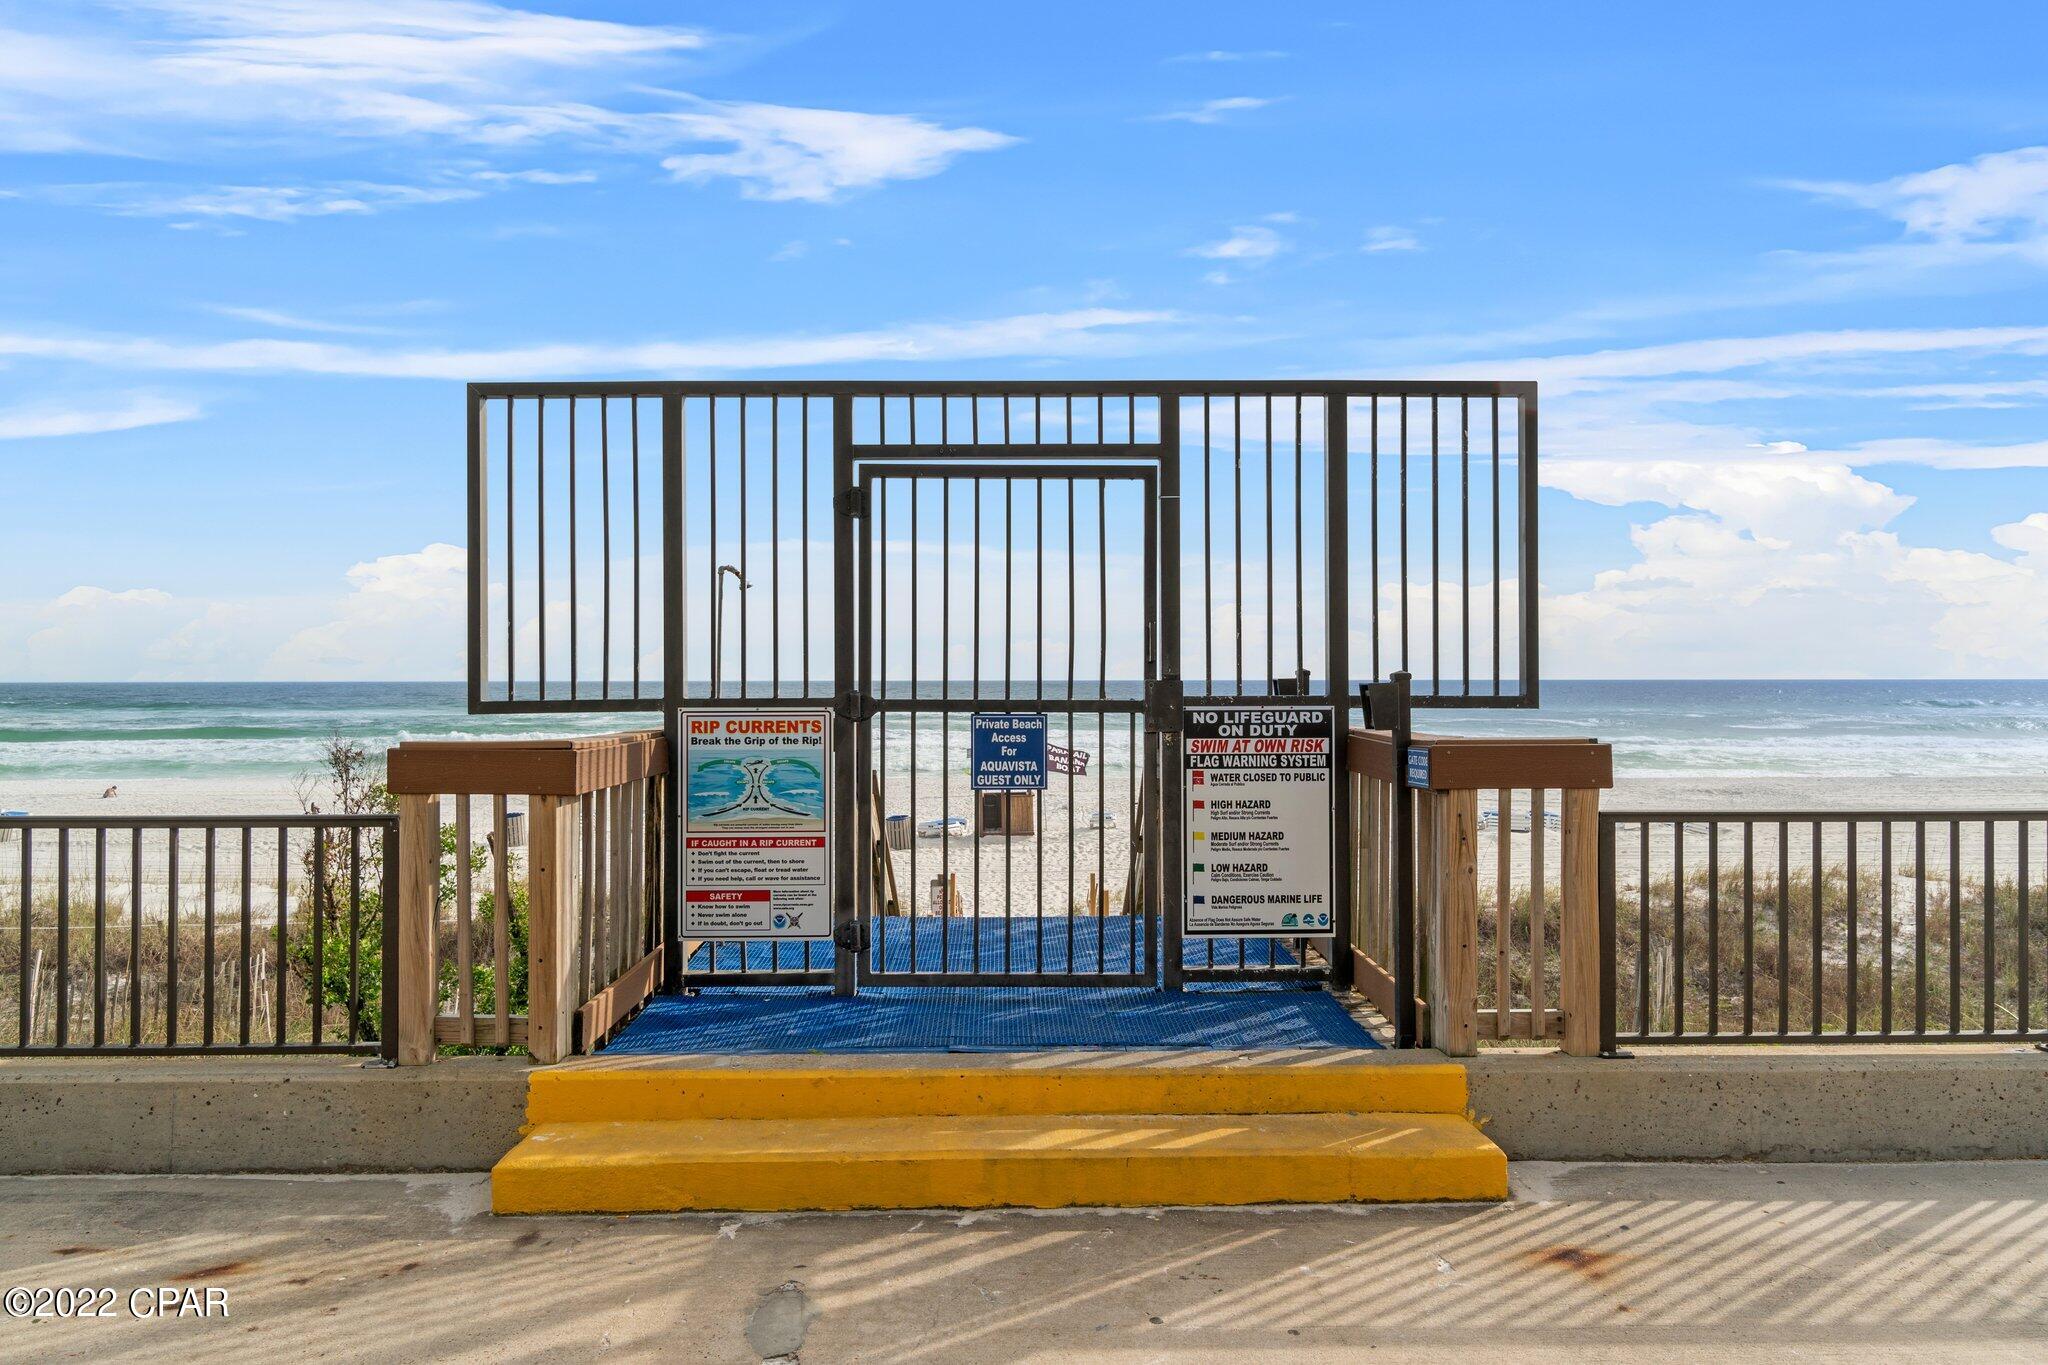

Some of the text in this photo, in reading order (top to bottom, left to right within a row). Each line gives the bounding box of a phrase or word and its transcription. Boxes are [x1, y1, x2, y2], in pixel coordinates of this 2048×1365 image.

[1193, 712, 1323, 724] NO LIFEGUARD
[691, 720, 822, 734] RIP CURRENTS
[976, 720, 1042, 729] Private Beach
[1218, 724, 1298, 736] ON DUTY
[691, 736, 822, 746] Break the Grip of the Rip!
[992, 732, 1026, 742] Access
[1002, 746, 1017, 756] For
[1191, 740, 1324, 752] SWIM AT OWN RISK
[981, 761, 1038, 771] AQUAVISTA
[1190, 755, 1326, 767] FLAG WARNING SYSTEM
[1408, 756, 1428, 766] GATE CODE
[977, 775, 1041, 785] GUEST ONLY
[1210, 773, 1326, 782] WATER CLOSED TO PUBLIC
[1211, 800, 1271, 808] HIGH HAZARD
[1211, 832, 1284, 840] MEDIUM HAZARD
[1211, 864, 1268, 872] LOW HAZARD
[1211, 895, 1322, 904] DANGEROUS MARINE LIFE
